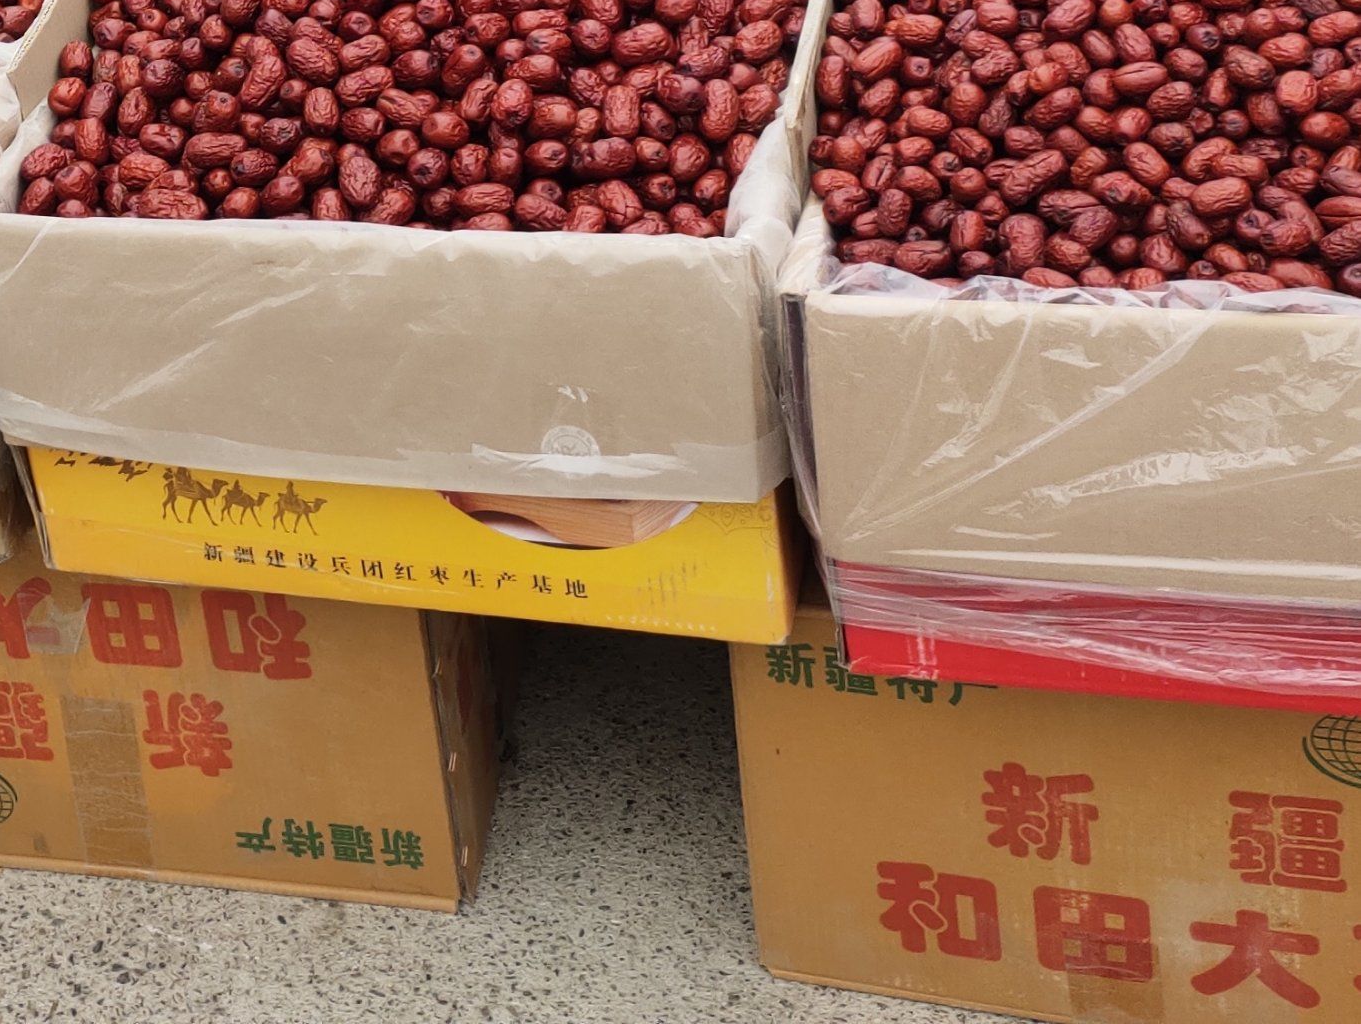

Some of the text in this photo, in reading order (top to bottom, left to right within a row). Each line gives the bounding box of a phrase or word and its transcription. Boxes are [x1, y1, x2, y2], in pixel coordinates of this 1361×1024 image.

[203, 540, 589, 599] 新疆建设兵团红枣生产基地
[236, 816, 424, 871] 新疆特产
[981, 762, 1347, 893] 新疆
[876, 861, 1361, 1010] 和田大
